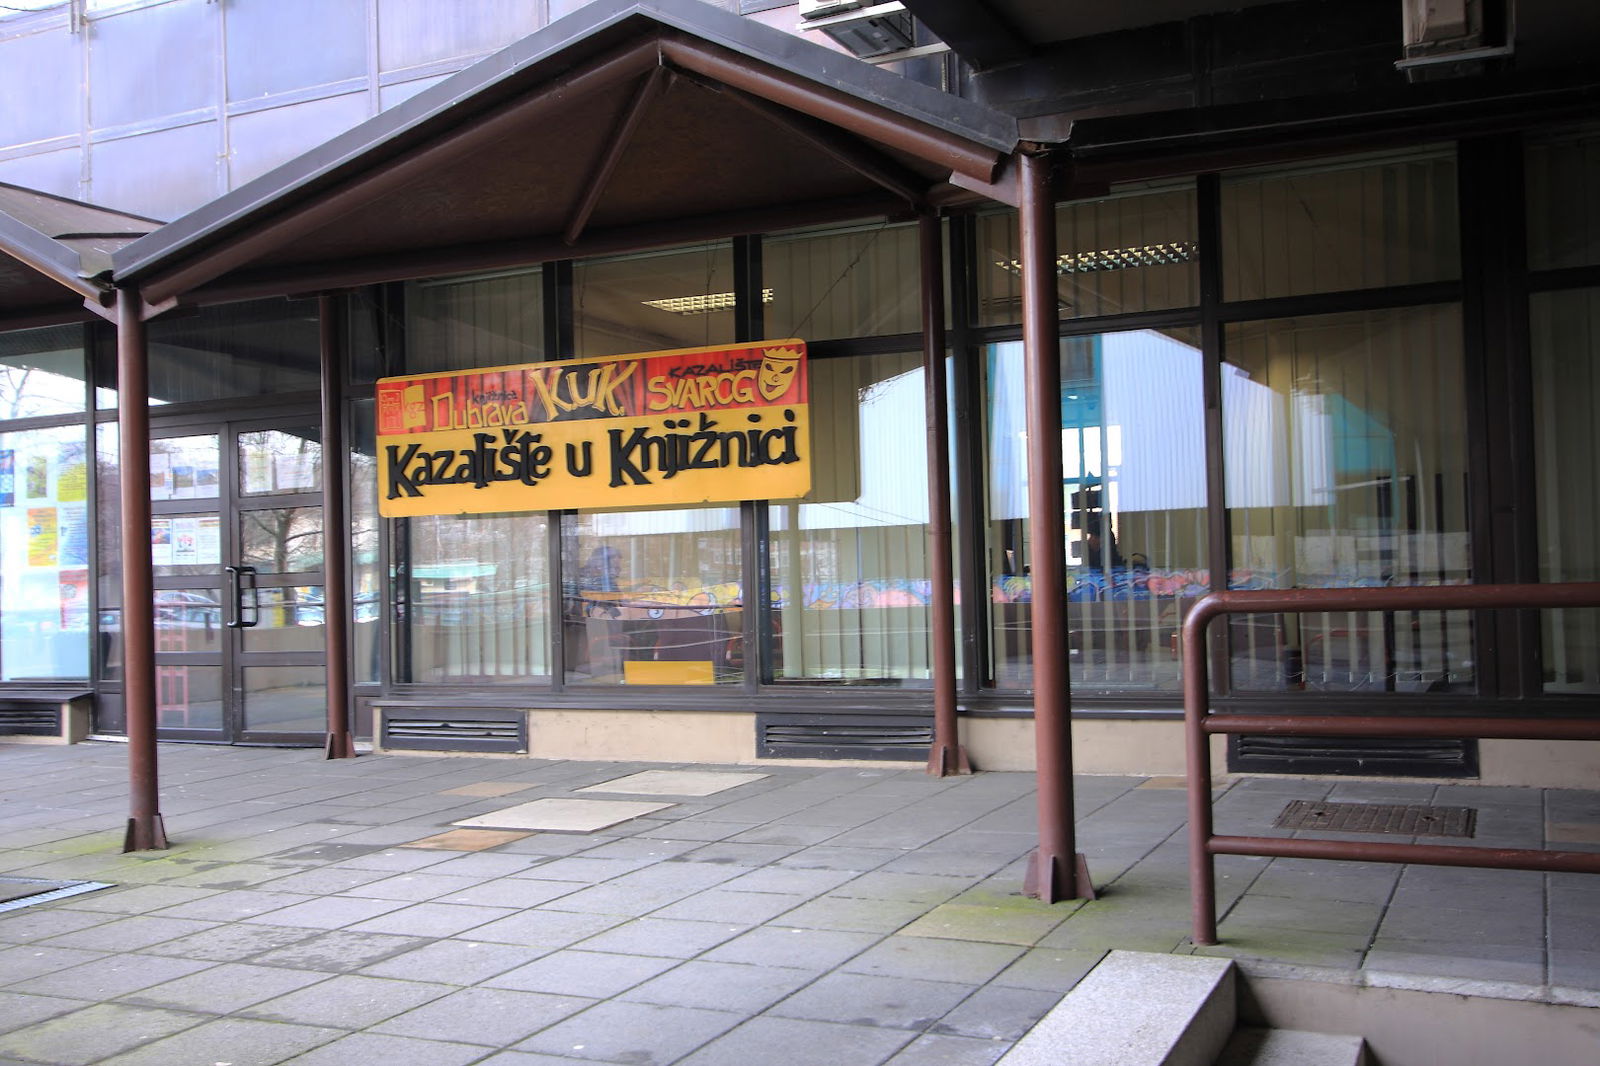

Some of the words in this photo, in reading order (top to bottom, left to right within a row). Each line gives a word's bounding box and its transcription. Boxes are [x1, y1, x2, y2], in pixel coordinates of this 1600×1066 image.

[431, 391, 529, 431] Dubrava
[648, 369, 757, 411] SVAROG
[385, 428, 552, 500] Kazalište
[566, 441, 593, 477] u
[607, 409, 800, 488] Knjižnici
